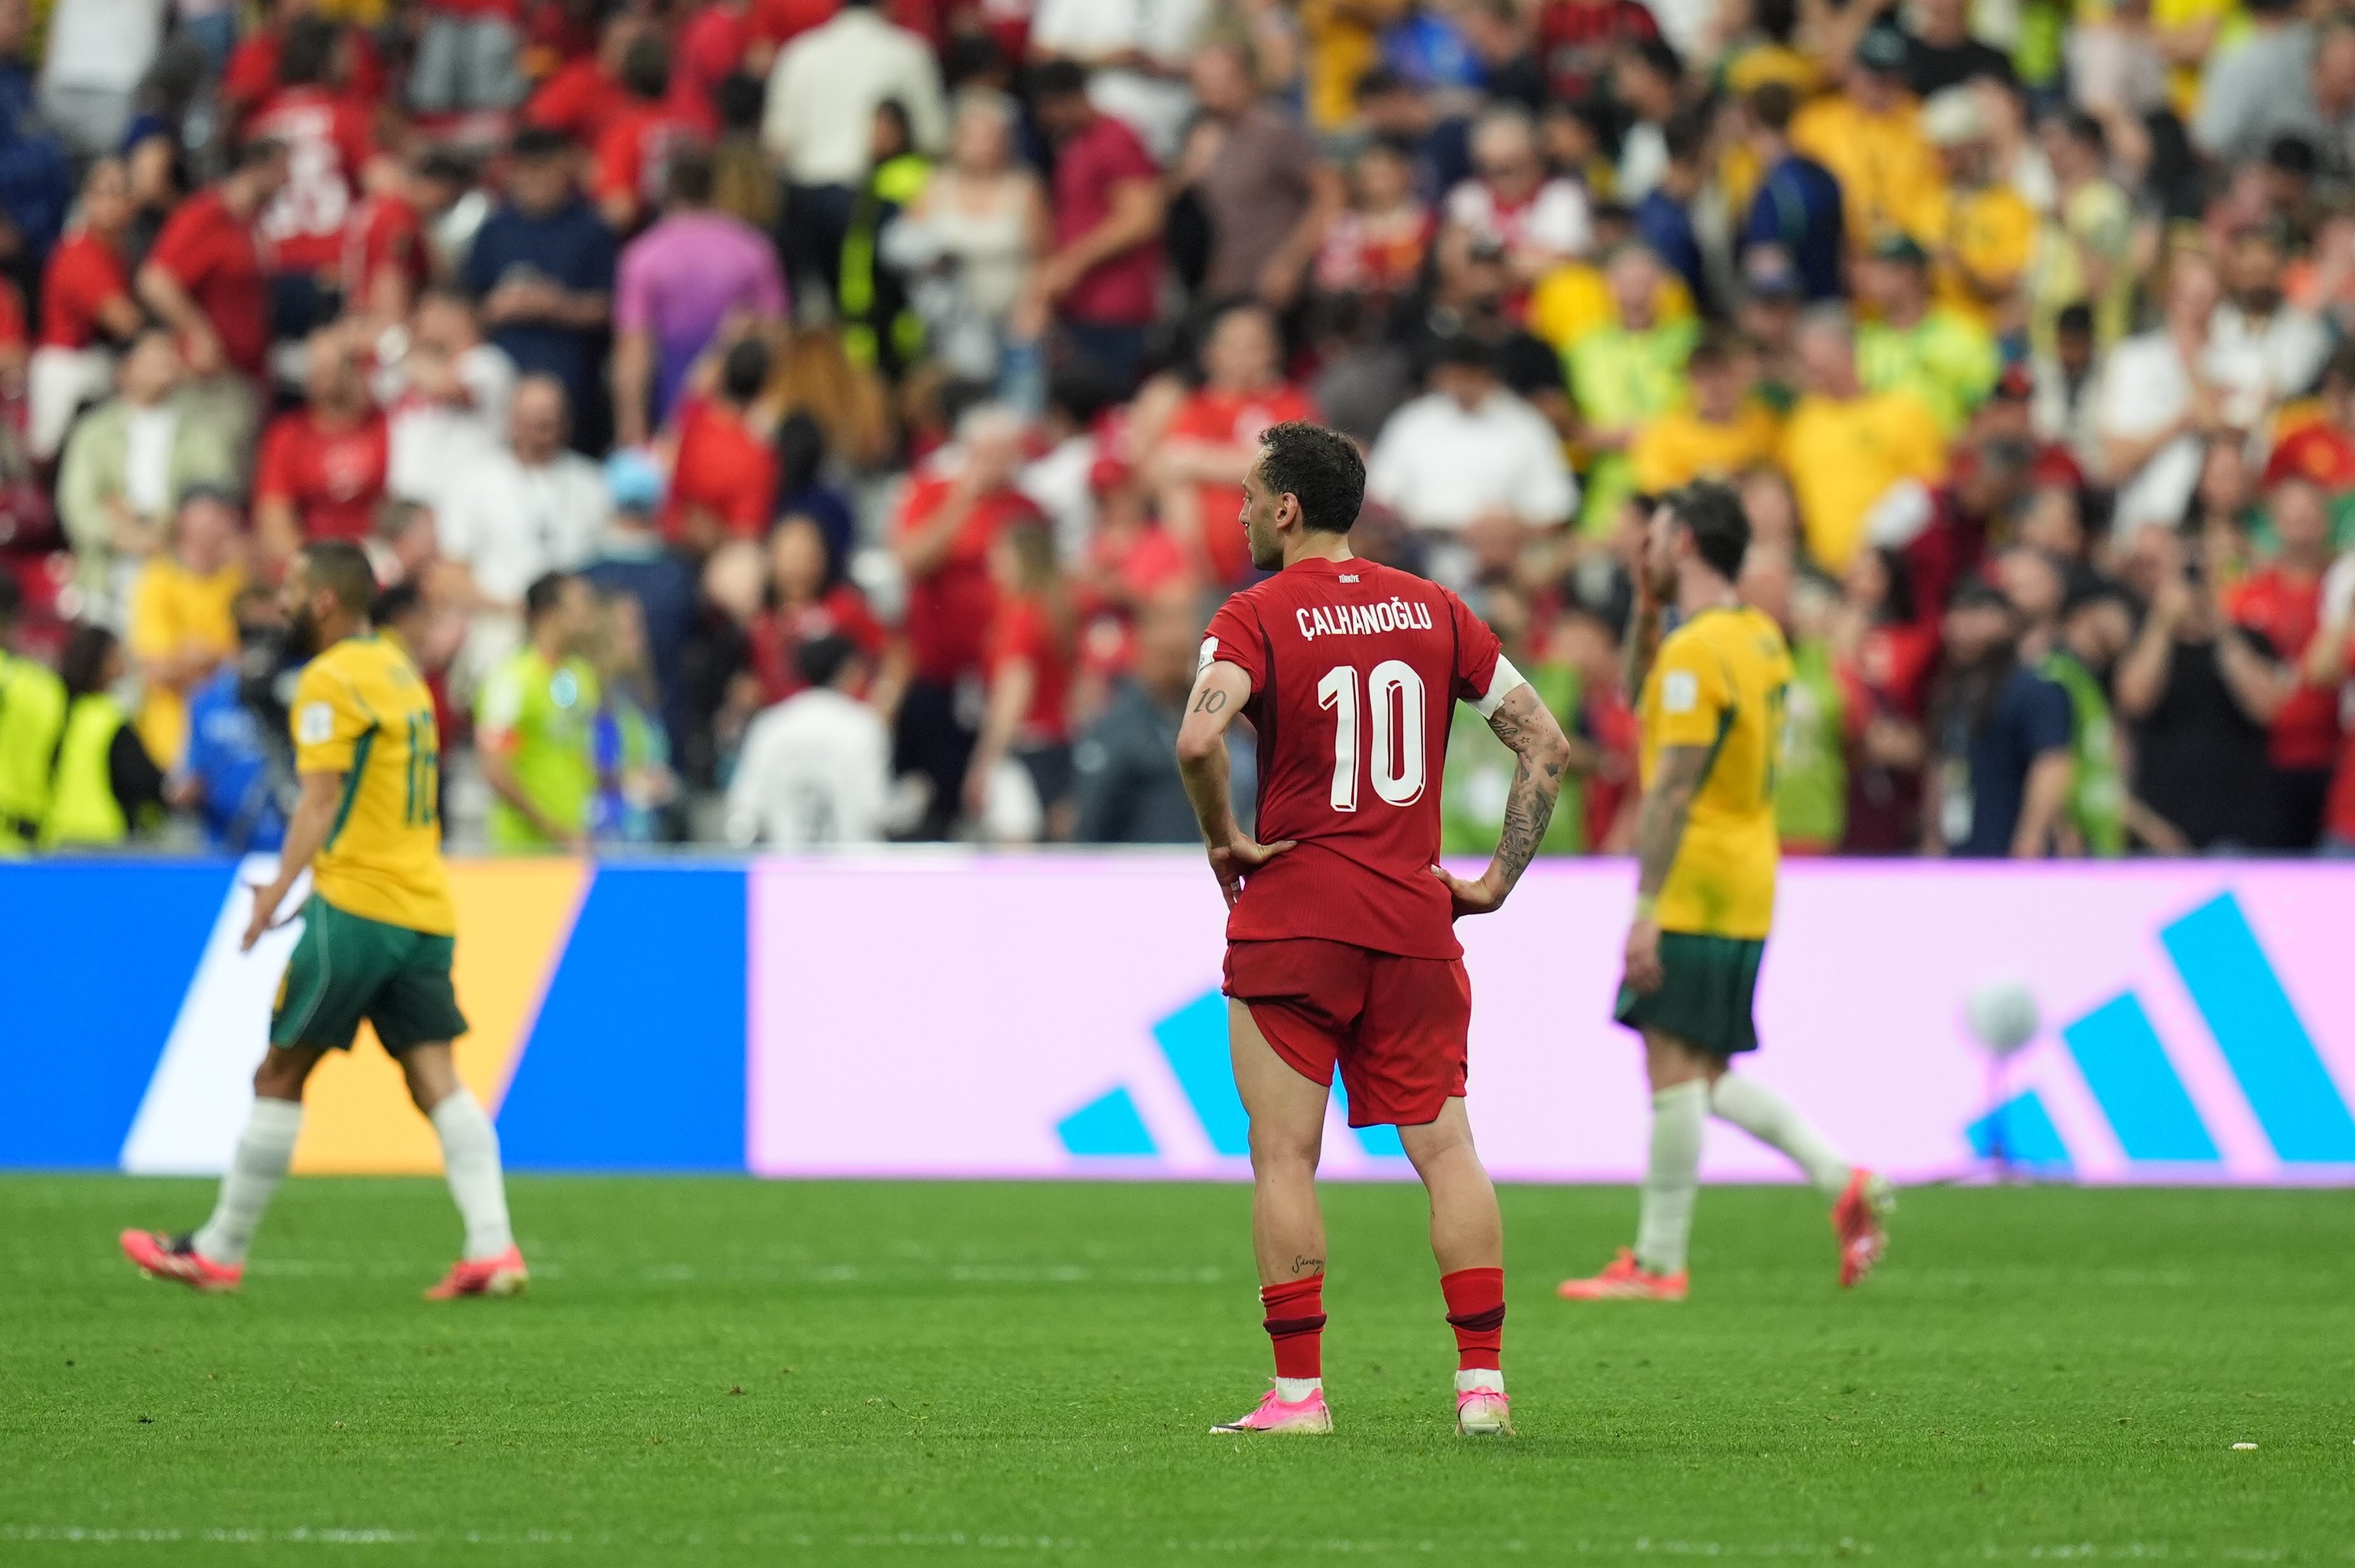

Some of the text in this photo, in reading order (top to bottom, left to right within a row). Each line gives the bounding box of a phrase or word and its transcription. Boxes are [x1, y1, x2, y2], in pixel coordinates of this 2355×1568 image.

[1296, 596, 1433, 641] ÇALHANOĞLU
[1193, 688, 1226, 714] 10
[1317, 660, 1426, 813] 10
